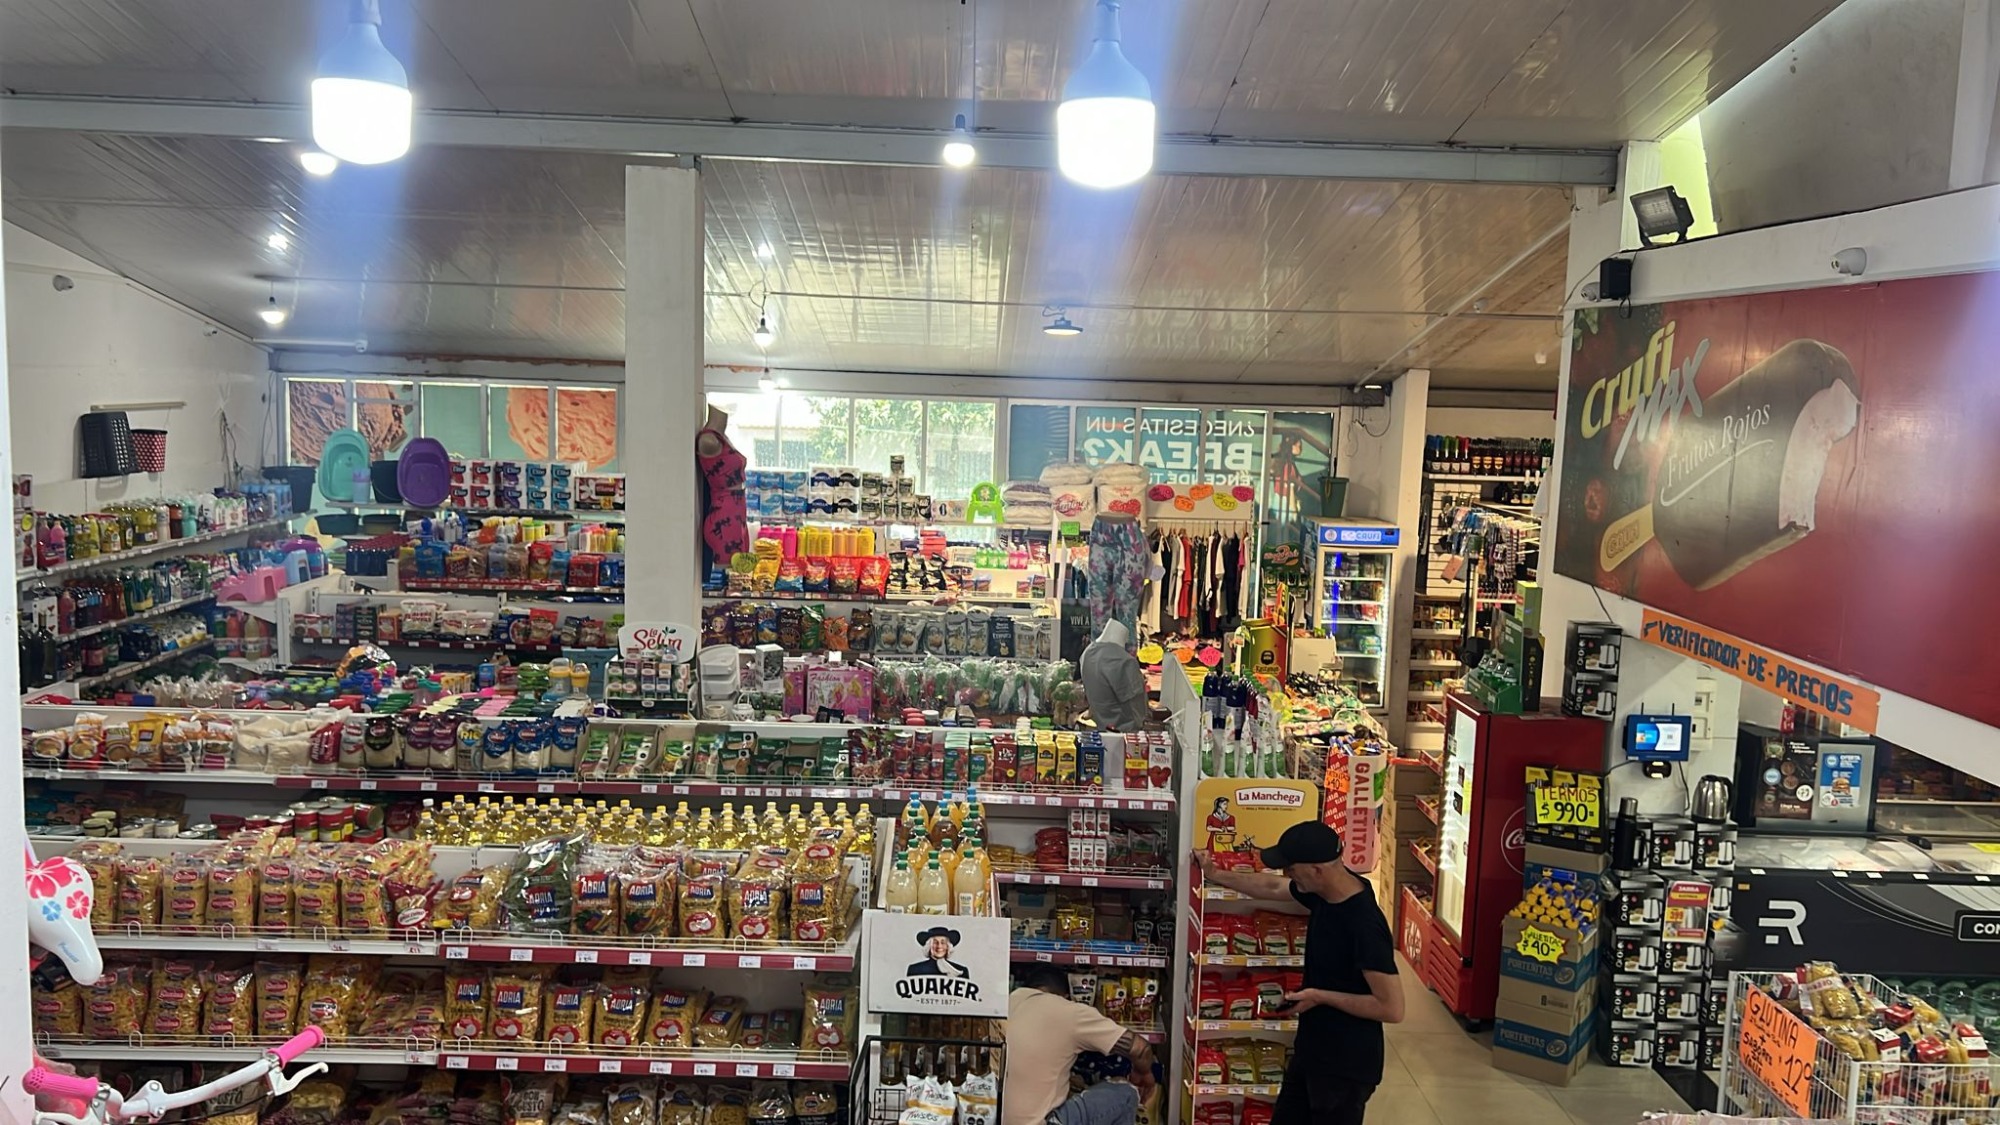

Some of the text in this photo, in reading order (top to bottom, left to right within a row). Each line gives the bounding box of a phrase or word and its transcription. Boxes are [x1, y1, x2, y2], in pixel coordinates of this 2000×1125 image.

[1665, 403, 1770, 488] Frutos Rojos
[650, 628, 658, 638] La
[1775, 664, 1853, 716] PRECIOS
[1238, 791, 1300, 803] La Manchega
[1541, 786, 1598, 803] TERMOS
[1351, 762, 1370, 866] GALLETITAS
[581, 881, 606, 894] ADRIA
[629, 885, 654, 896] ADRIA
[689, 886, 712, 897] ADRIA
[745, 889, 768, 901] ADRIA
[799, 889, 821, 900] ADRIA
[458, 984, 480, 996] ADRIA
[895, 978, 980, 1002] QUAKER
[497, 991, 521, 1003] ADRIA
[556, 994, 579, 1006] ADRIA
[663, 995, 685, 1004] ADRIA
[610, 998, 633, 1011] ADRIA
[820, 999, 843, 1011] ADRIA
